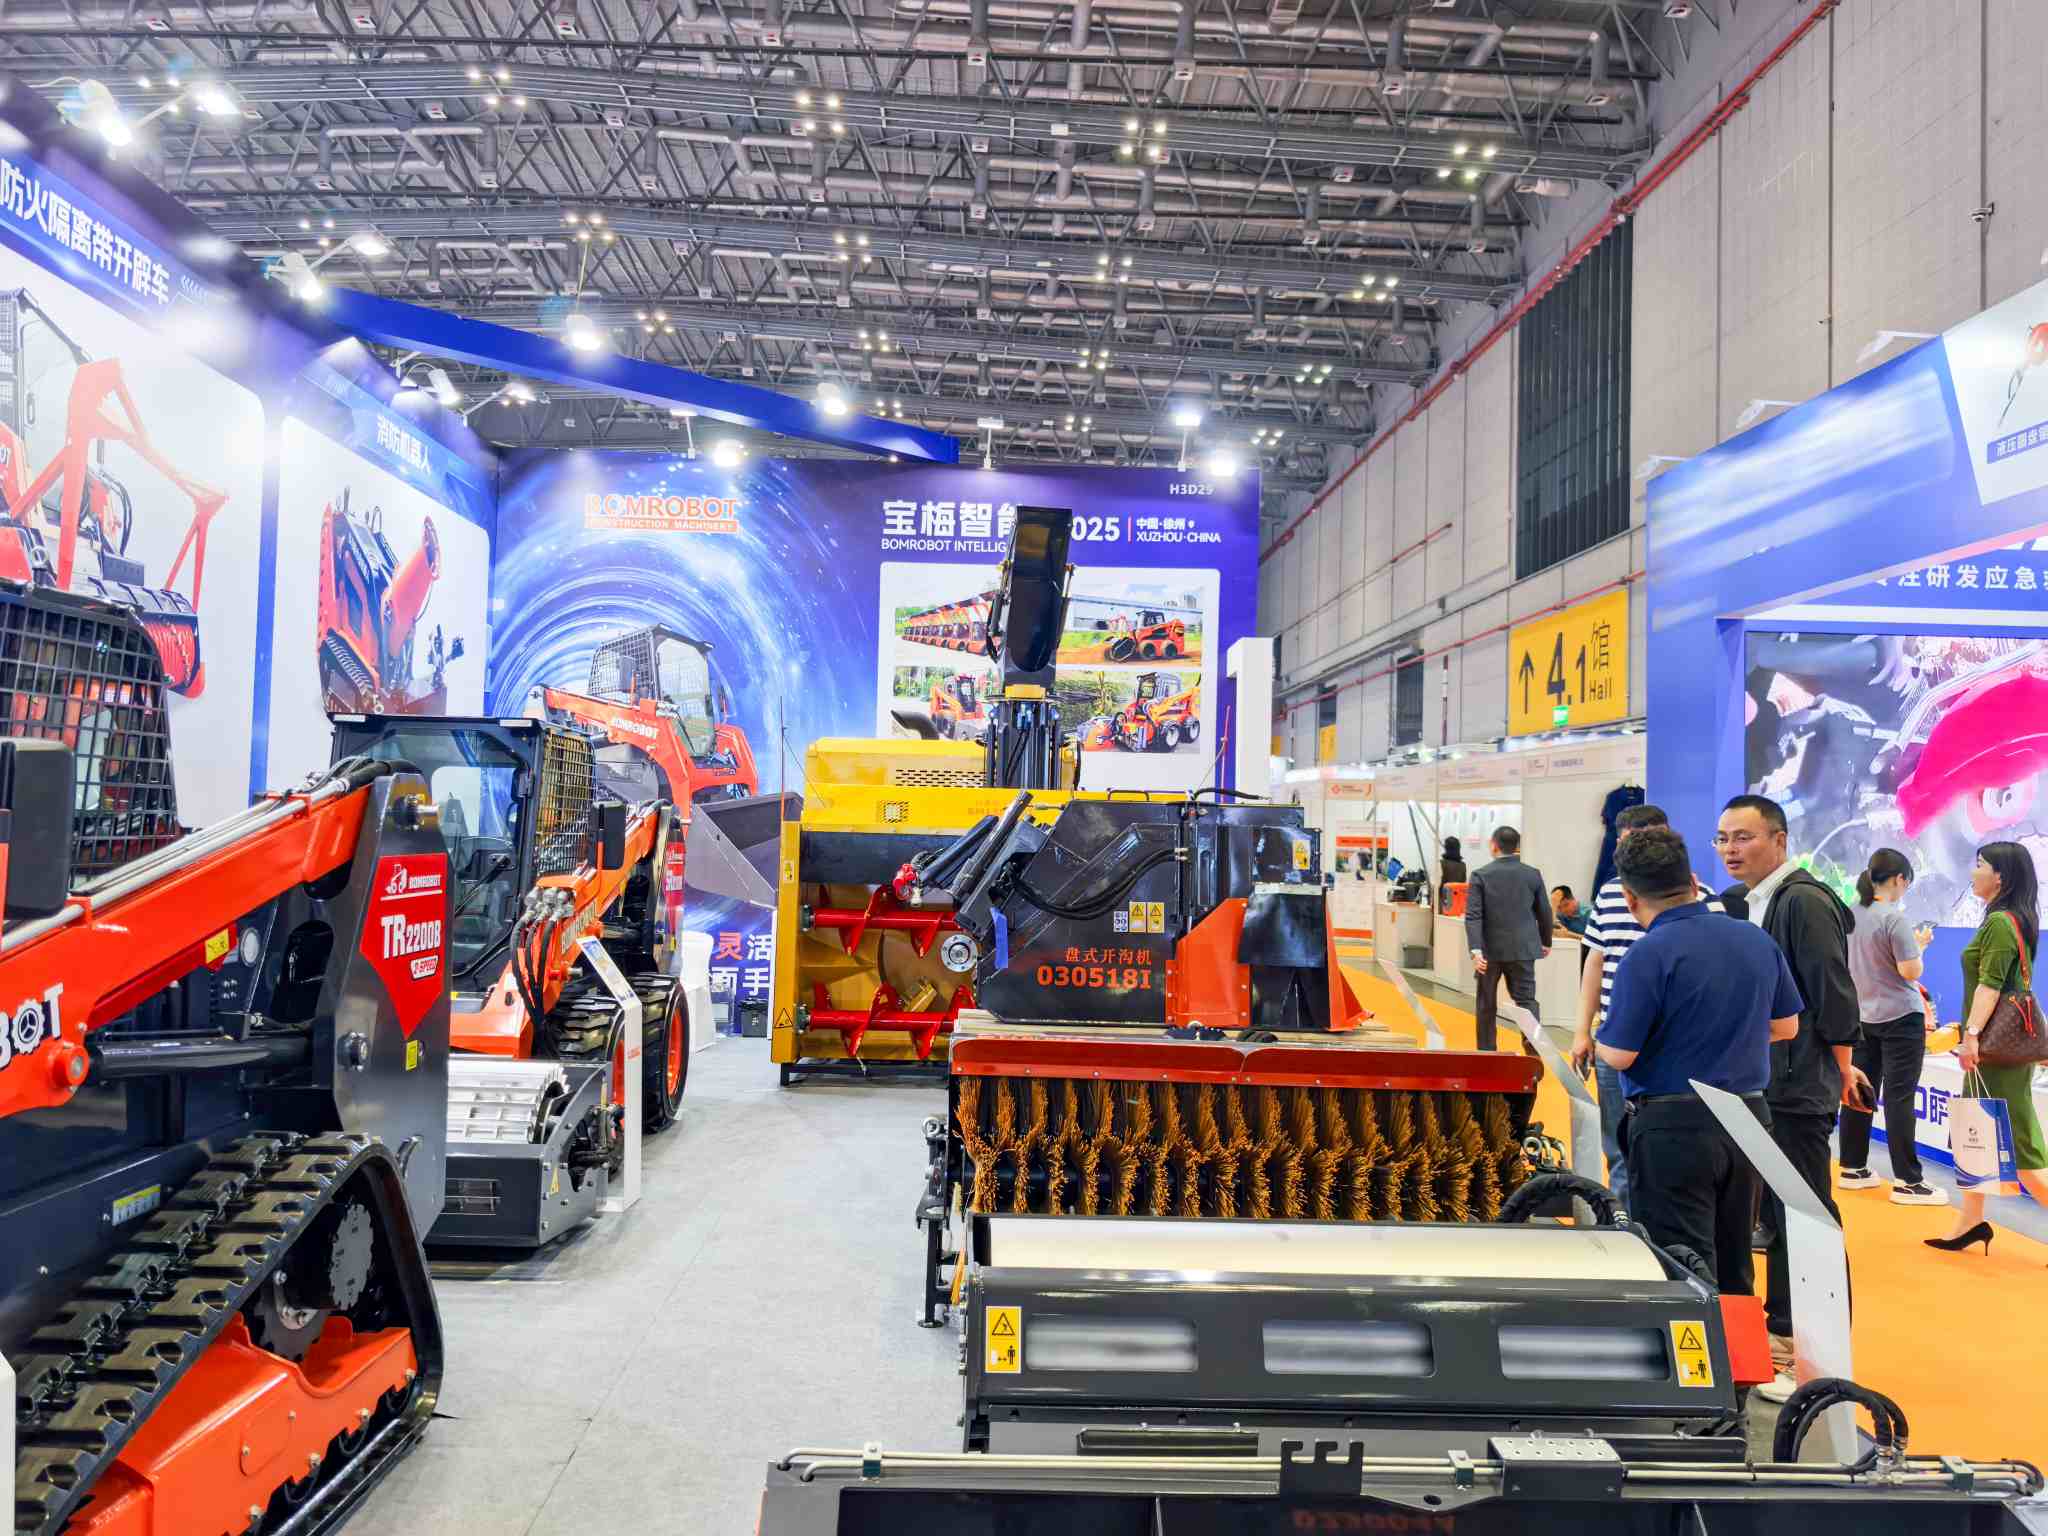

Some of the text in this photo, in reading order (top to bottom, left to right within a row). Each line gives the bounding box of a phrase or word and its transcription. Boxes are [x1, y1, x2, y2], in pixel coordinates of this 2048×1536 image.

[376, 414, 431, 474] 消防机器人
[881, 538, 952, 551] BOMROBOT
[1876, 564, 2048, 590] 注研发应急
[1547, 631, 1587, 706] 4.1
[1589, 677, 1613, 702] Hall
